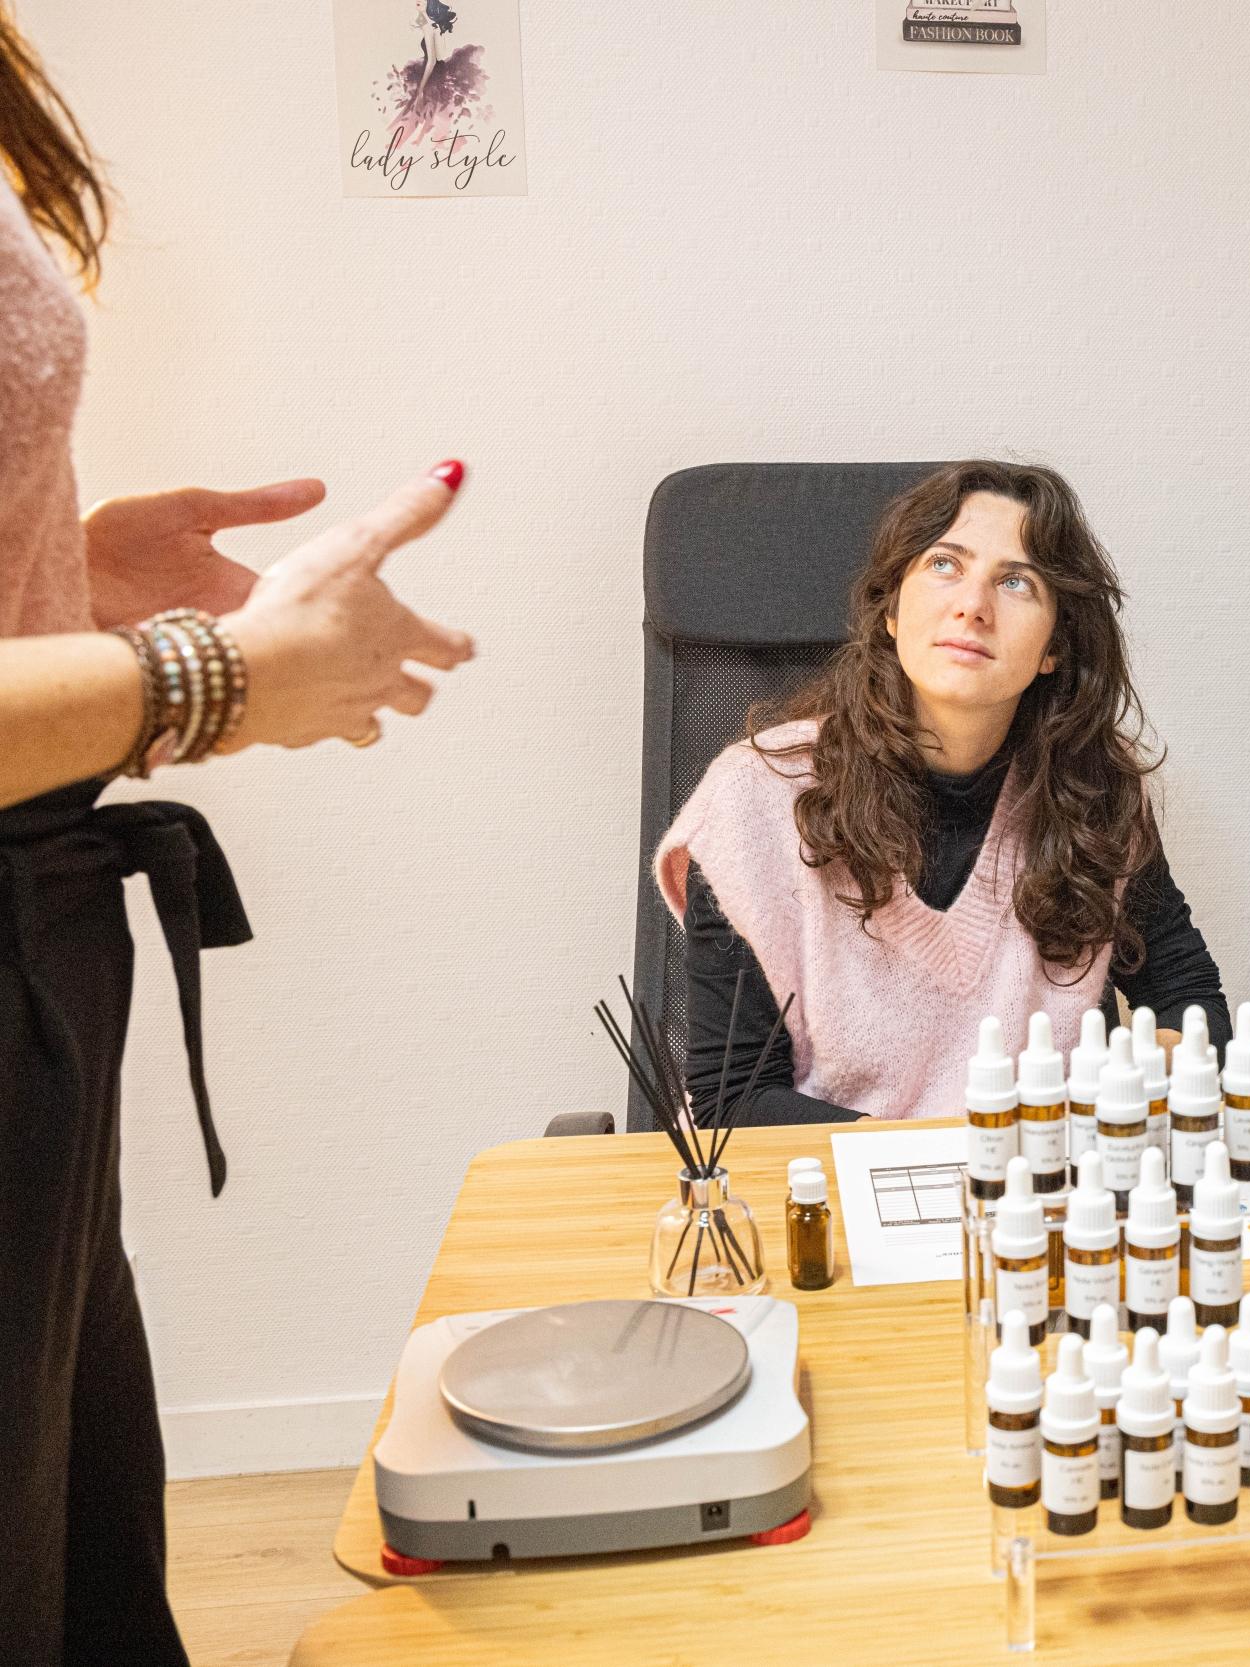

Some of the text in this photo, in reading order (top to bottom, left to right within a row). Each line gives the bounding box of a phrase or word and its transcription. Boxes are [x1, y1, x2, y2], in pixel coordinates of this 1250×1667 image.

[909, 25, 1014, 42] FASHION BOOK
[350, 126, 516, 190] lady style
